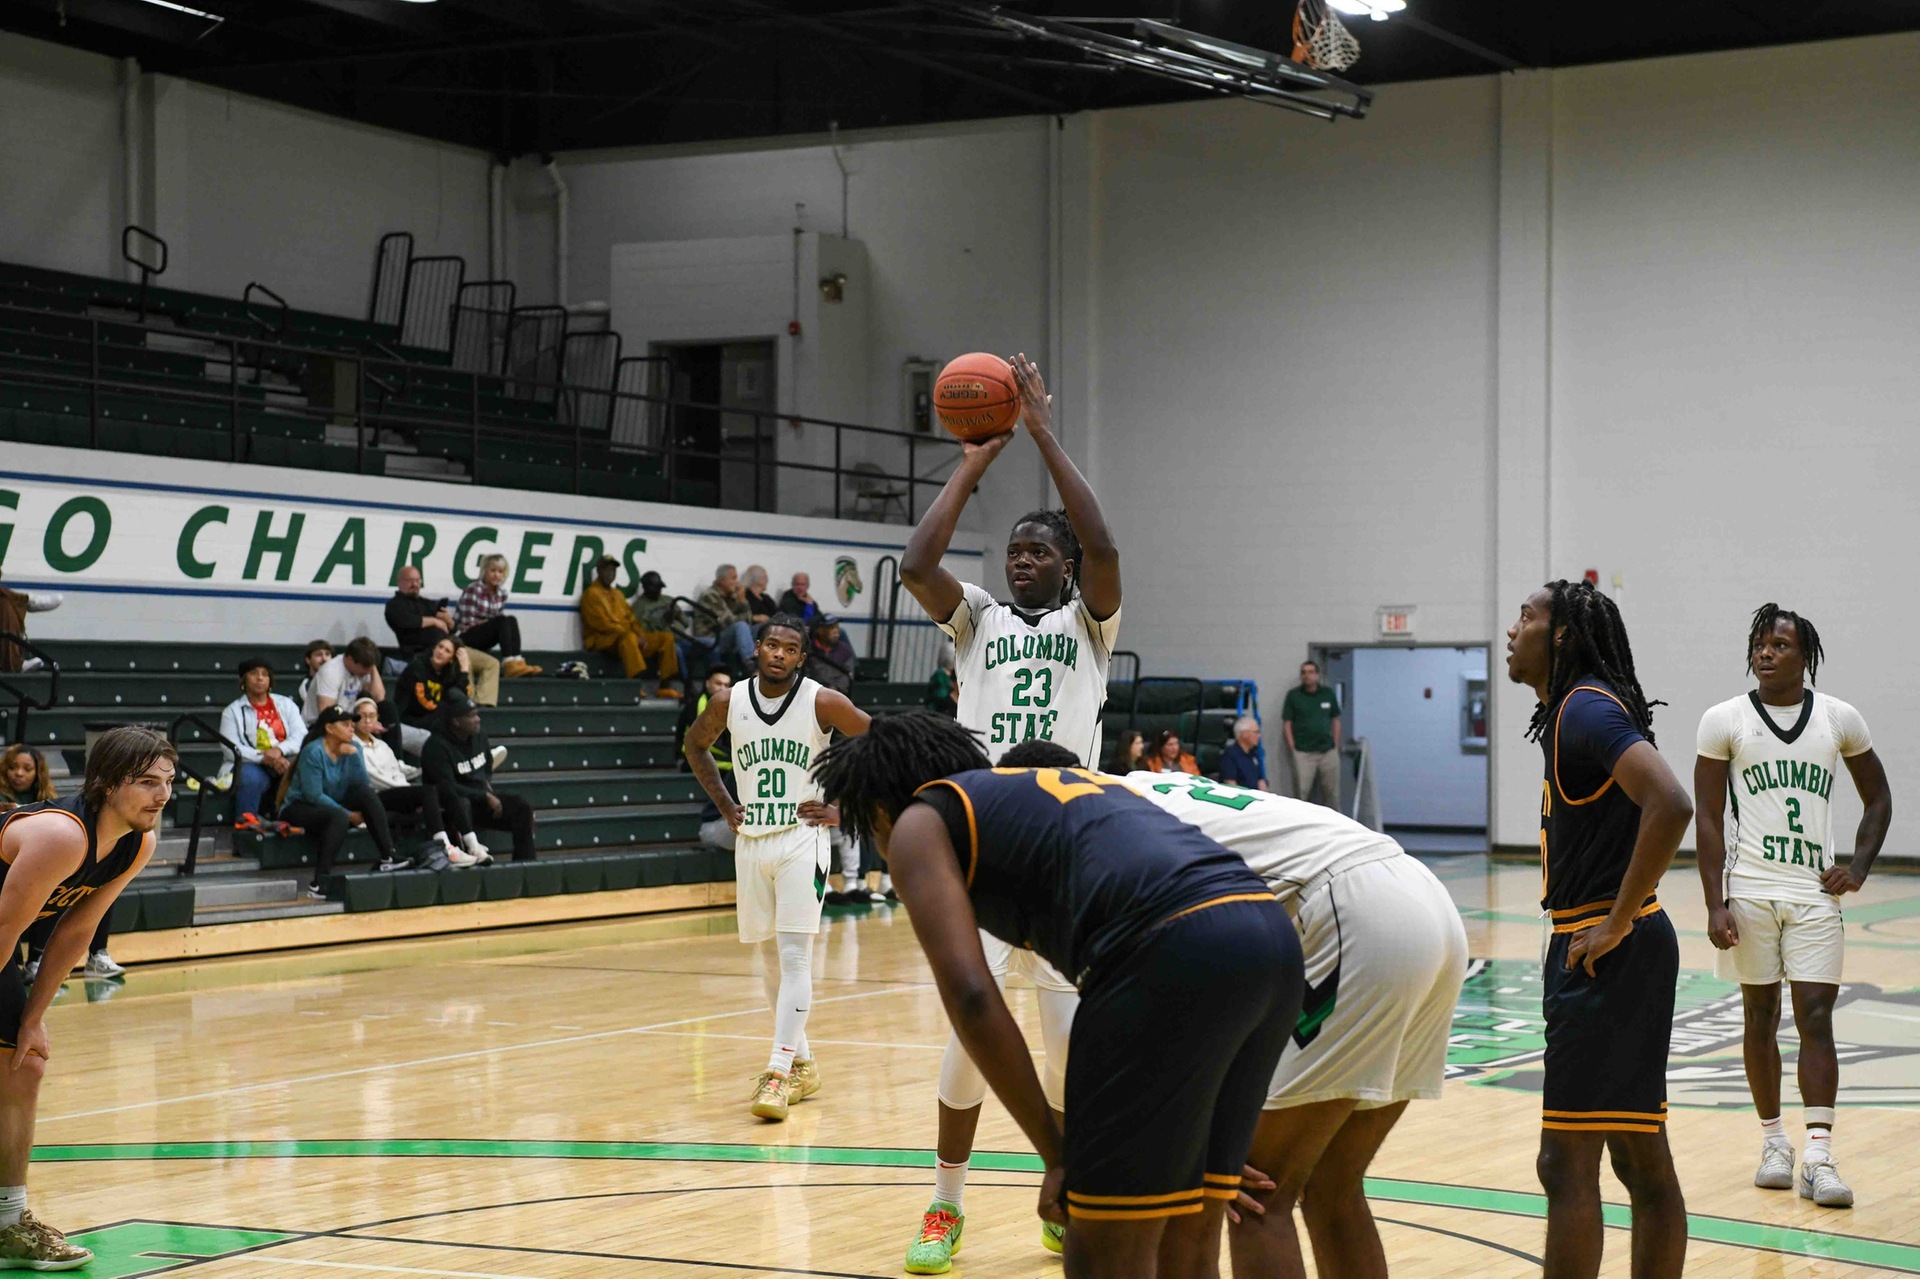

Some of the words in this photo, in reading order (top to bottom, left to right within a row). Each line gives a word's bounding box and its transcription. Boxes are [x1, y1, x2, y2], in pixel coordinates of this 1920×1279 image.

[175, 504, 648, 600] CHARGERS
[985, 633, 1079, 671] COLUMBIA
[1012, 667, 1053, 708] 23
[990, 709, 1058, 744] STATE
[736, 737, 811, 772] COLUMBIA
[757, 767, 786, 798] 20
[744, 802, 798, 826] STATE
[1785, 797, 1804, 834] 2
